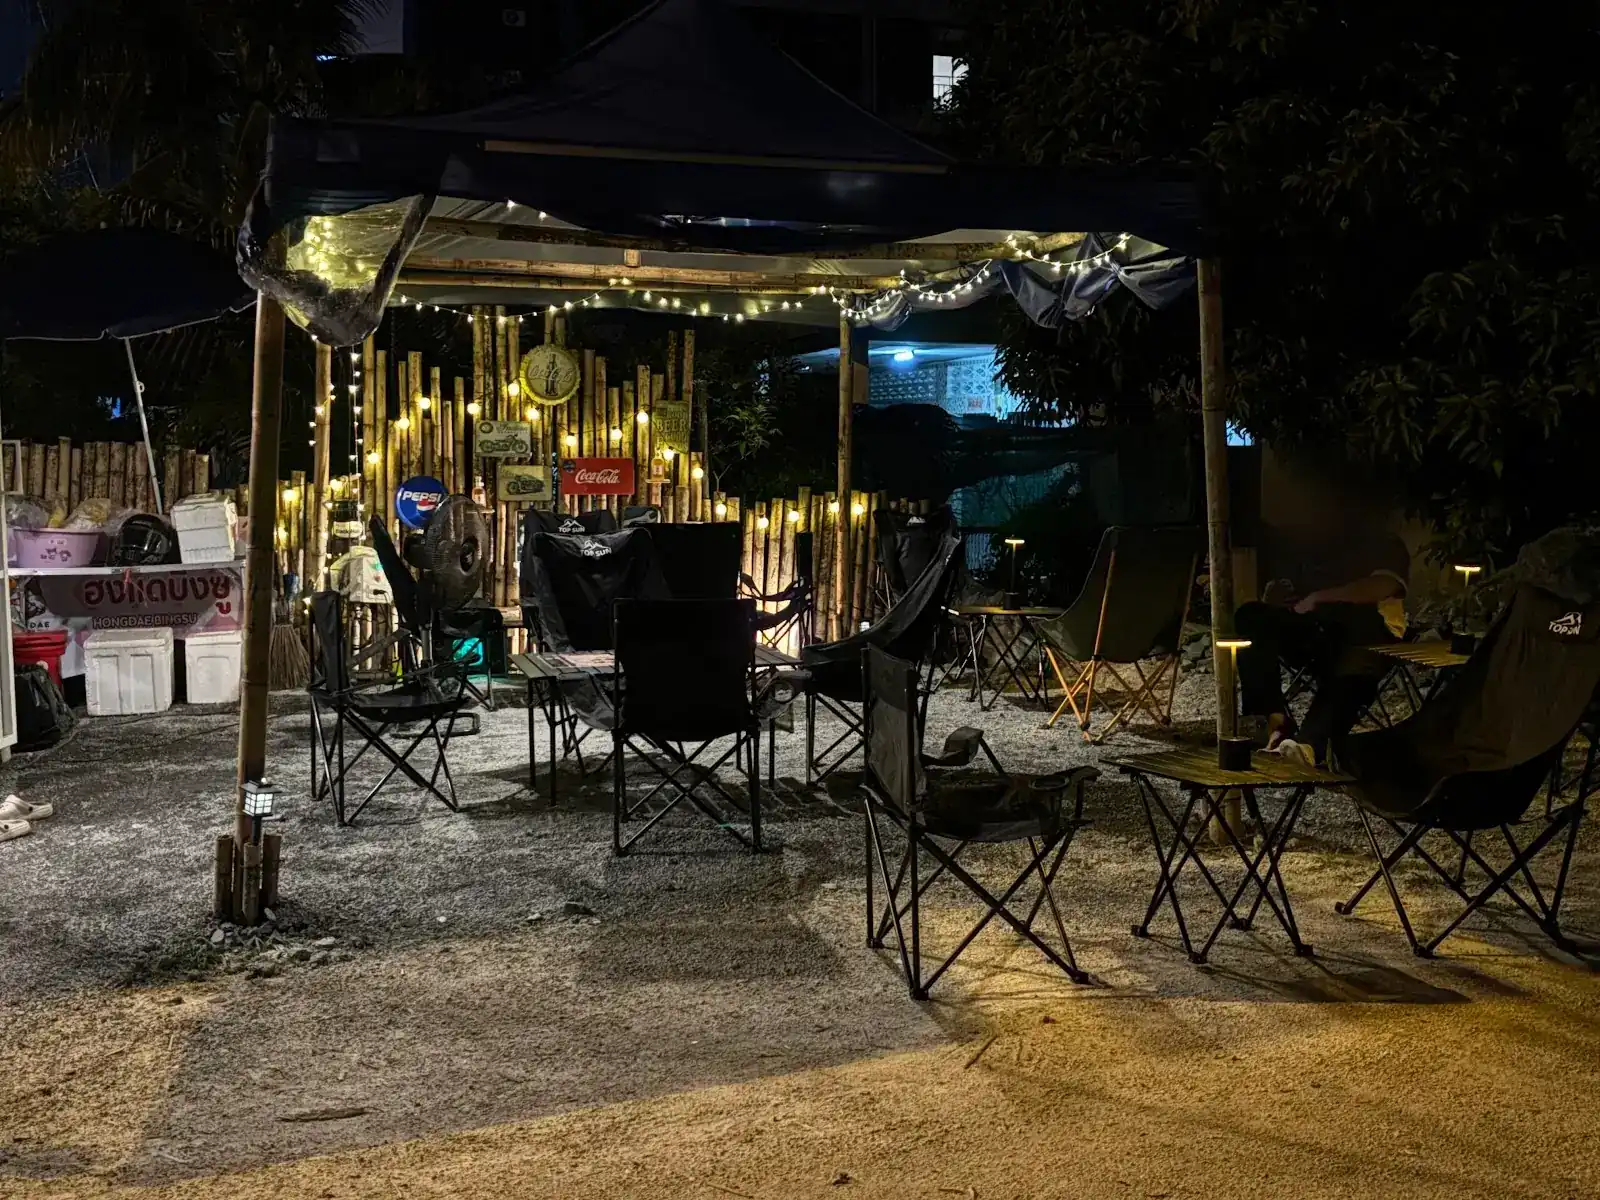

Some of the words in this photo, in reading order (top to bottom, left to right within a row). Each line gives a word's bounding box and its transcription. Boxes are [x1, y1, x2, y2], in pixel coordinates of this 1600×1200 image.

[574, 468, 620, 484] Coca-Cola
[402, 491, 442, 503] PEPSI
[572, 525, 586, 533] SUN
[580, 549, 594, 557] TOP
[595, 547, 612, 559] SUN
[92, 614, 153, 629] HONGDAE
[153, 612, 198, 626] BINGSU
[1548, 620, 1568, 634] TOP
